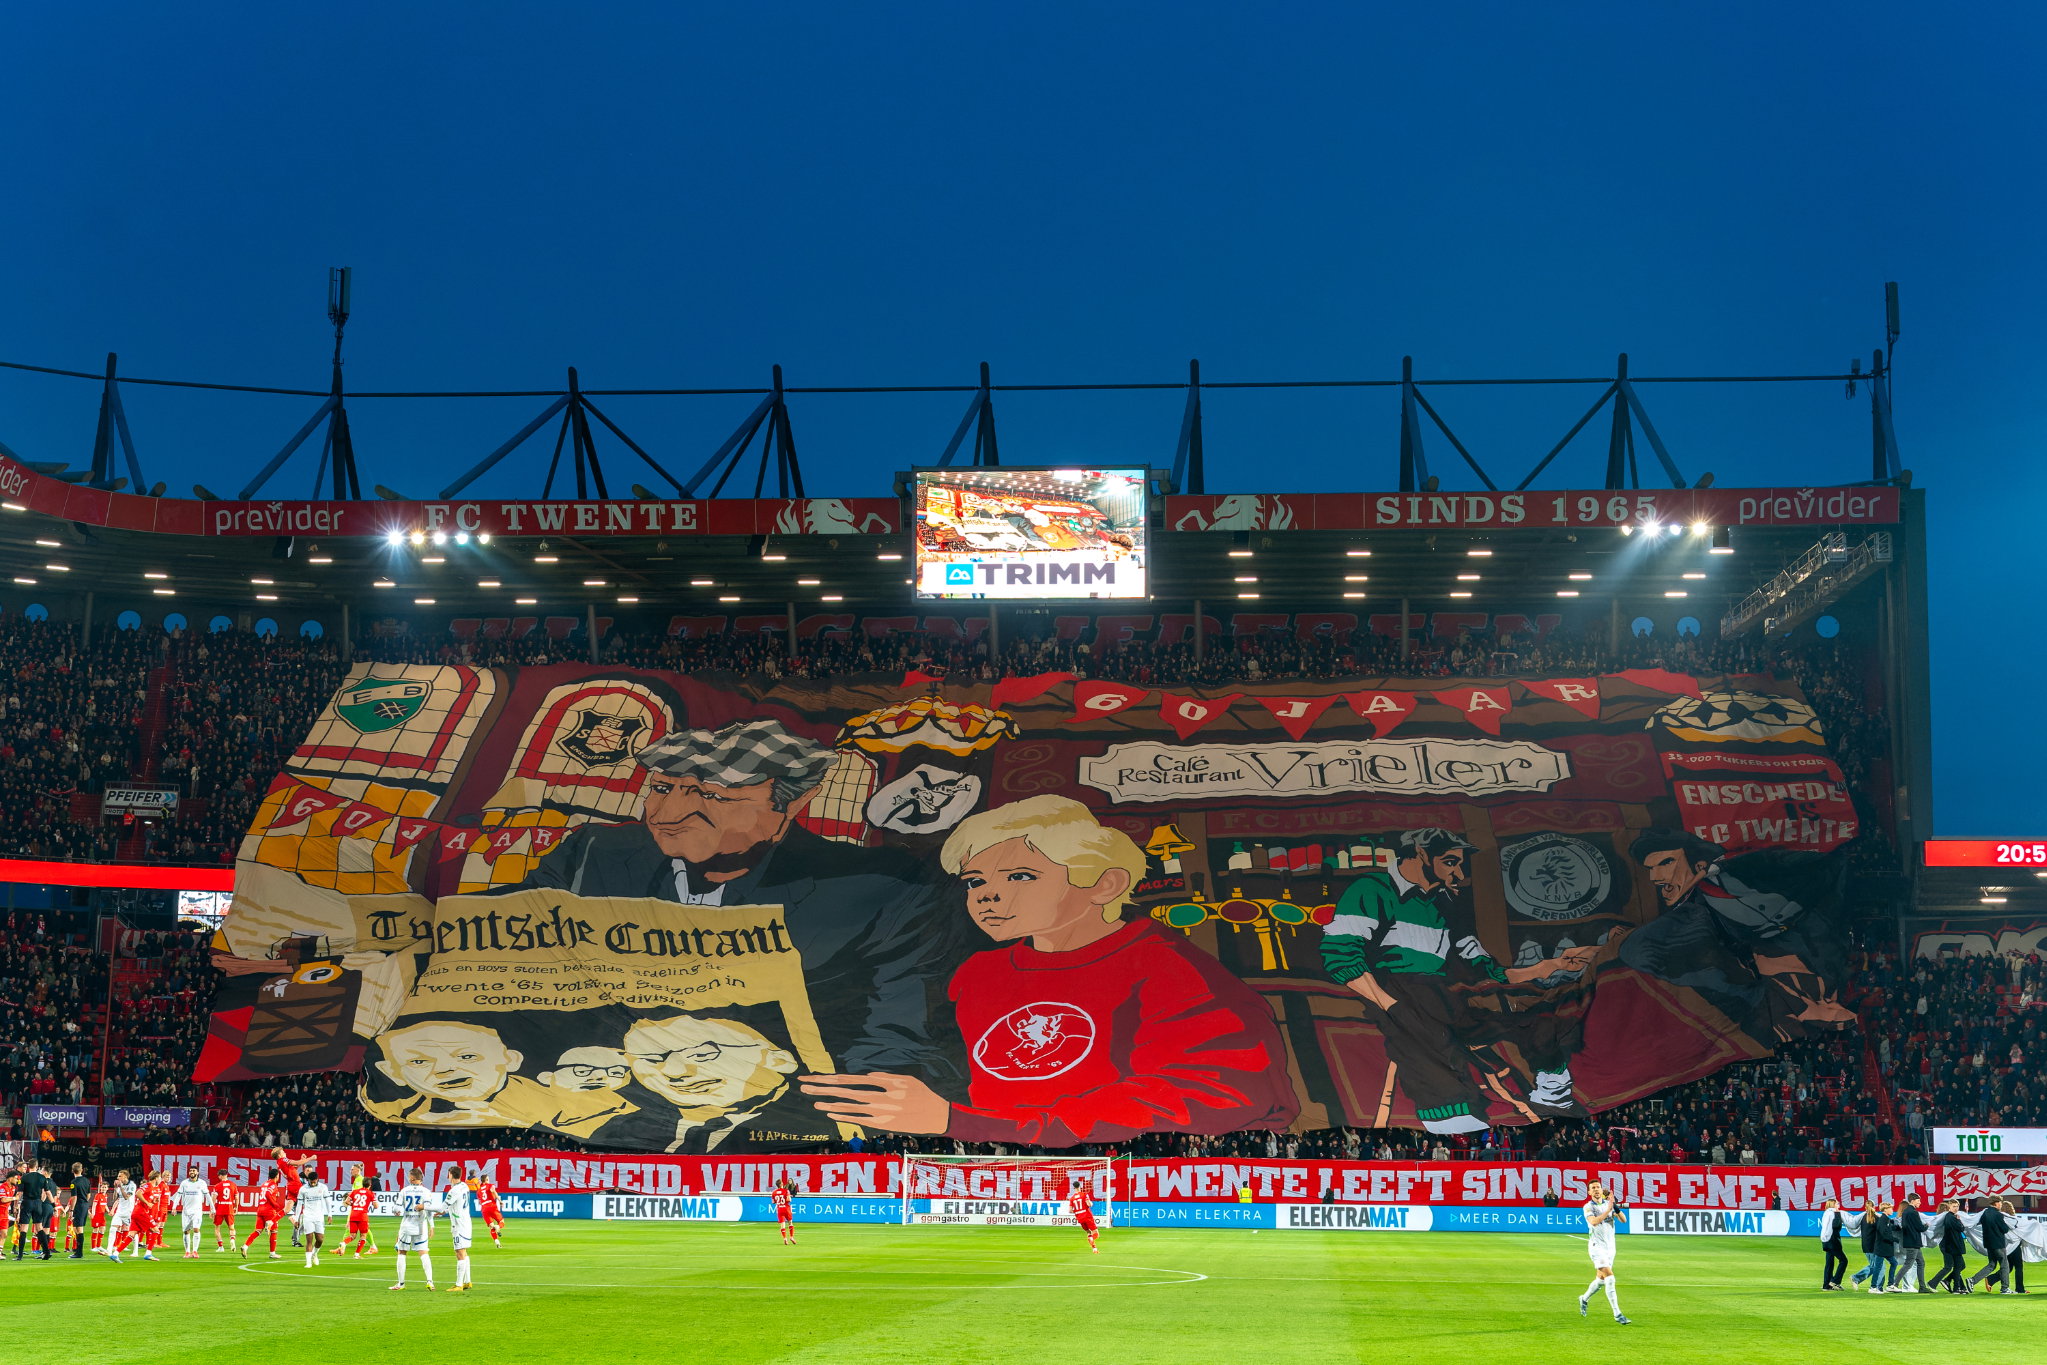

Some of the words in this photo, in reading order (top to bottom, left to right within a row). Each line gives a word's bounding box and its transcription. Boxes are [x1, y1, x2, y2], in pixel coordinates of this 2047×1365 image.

[424, 503, 482, 532] FC
[501, 503, 698, 531] TWENTE
[1376, 495, 1526, 524] SINDS
[1551, 496, 1657, 522] 1965
[1739, 490, 1881, 525] previder
[216, 503, 344, 535] previder
[977, 562, 1116, 585] TRIMM
[1276, 682, 1599, 719] JAAR
[1152, 752, 1209, 773] Café
[1226, 743, 1534, 790] Vrieler
[1117, 767, 1245, 787] Restaurant
[106, 790, 162, 803] PFEIFER
[1681, 782, 1847, 806] ENSCHEDE
[401, 823, 558, 852] JAAR
[1735, 817, 1856, 844] TWENTE
[1531, 897, 1601, 921] EREDIVISIE
[604, 917, 792, 958] Courant
[725, 974, 746, 988] in
[38, 1107, 85, 1123] looping
[124, 1108, 171, 1124] looping
[748, 1130, 764, 1142] 14
[765, 1130, 800, 1141] APRIL
[1956, 1134, 2002, 1152] TOTO
[150, 1154, 217, 1190] UIT
[374, 1157, 499, 1192] KWAM
[508, 1156, 690, 1196] EENHEID,
[700, 1161, 810, 1194] VUUR
[820, 1160, 877, 1194] EN
[887, 1161, 1057, 1201] KRACHT,
[1127, 1163, 1307, 1198] TWENTE
[1318, 1167, 1452, 1202] LEEFT
[1462, 1167, 1588, 1201] SINDS
[1597, 1169, 1668, 1205] DIE
[1678, 1173, 1766, 1210] ENE
[1776, 1172, 1938, 1210] NACHT!
[222, 1187, 231, 1200] 9
[353, 1193, 367, 1207] 28
[405, 1195, 422, 1212] 23
[774, 1195, 786, 1205] 23
[605, 1196, 720, 1220] ELEKTRAMAT
[768, 1203, 807, 1215] MER
[814, 1204, 844, 1216] DAN
[1073, 1199, 1084, 1211] 17
[1157, 1208, 1187, 1220] DAN
[1195, 1209, 1262, 1221] ELEKTRA
[1290, 1206, 1409, 1229] ELEKTRAMAT
[1460, 1212, 1500, 1225] MEER
[1507, 1212, 1539, 1226] DAN
[1546, 1213, 1584, 1227] ELEK
[1643, 1210, 1766, 1235] ELEKTRAMAT
